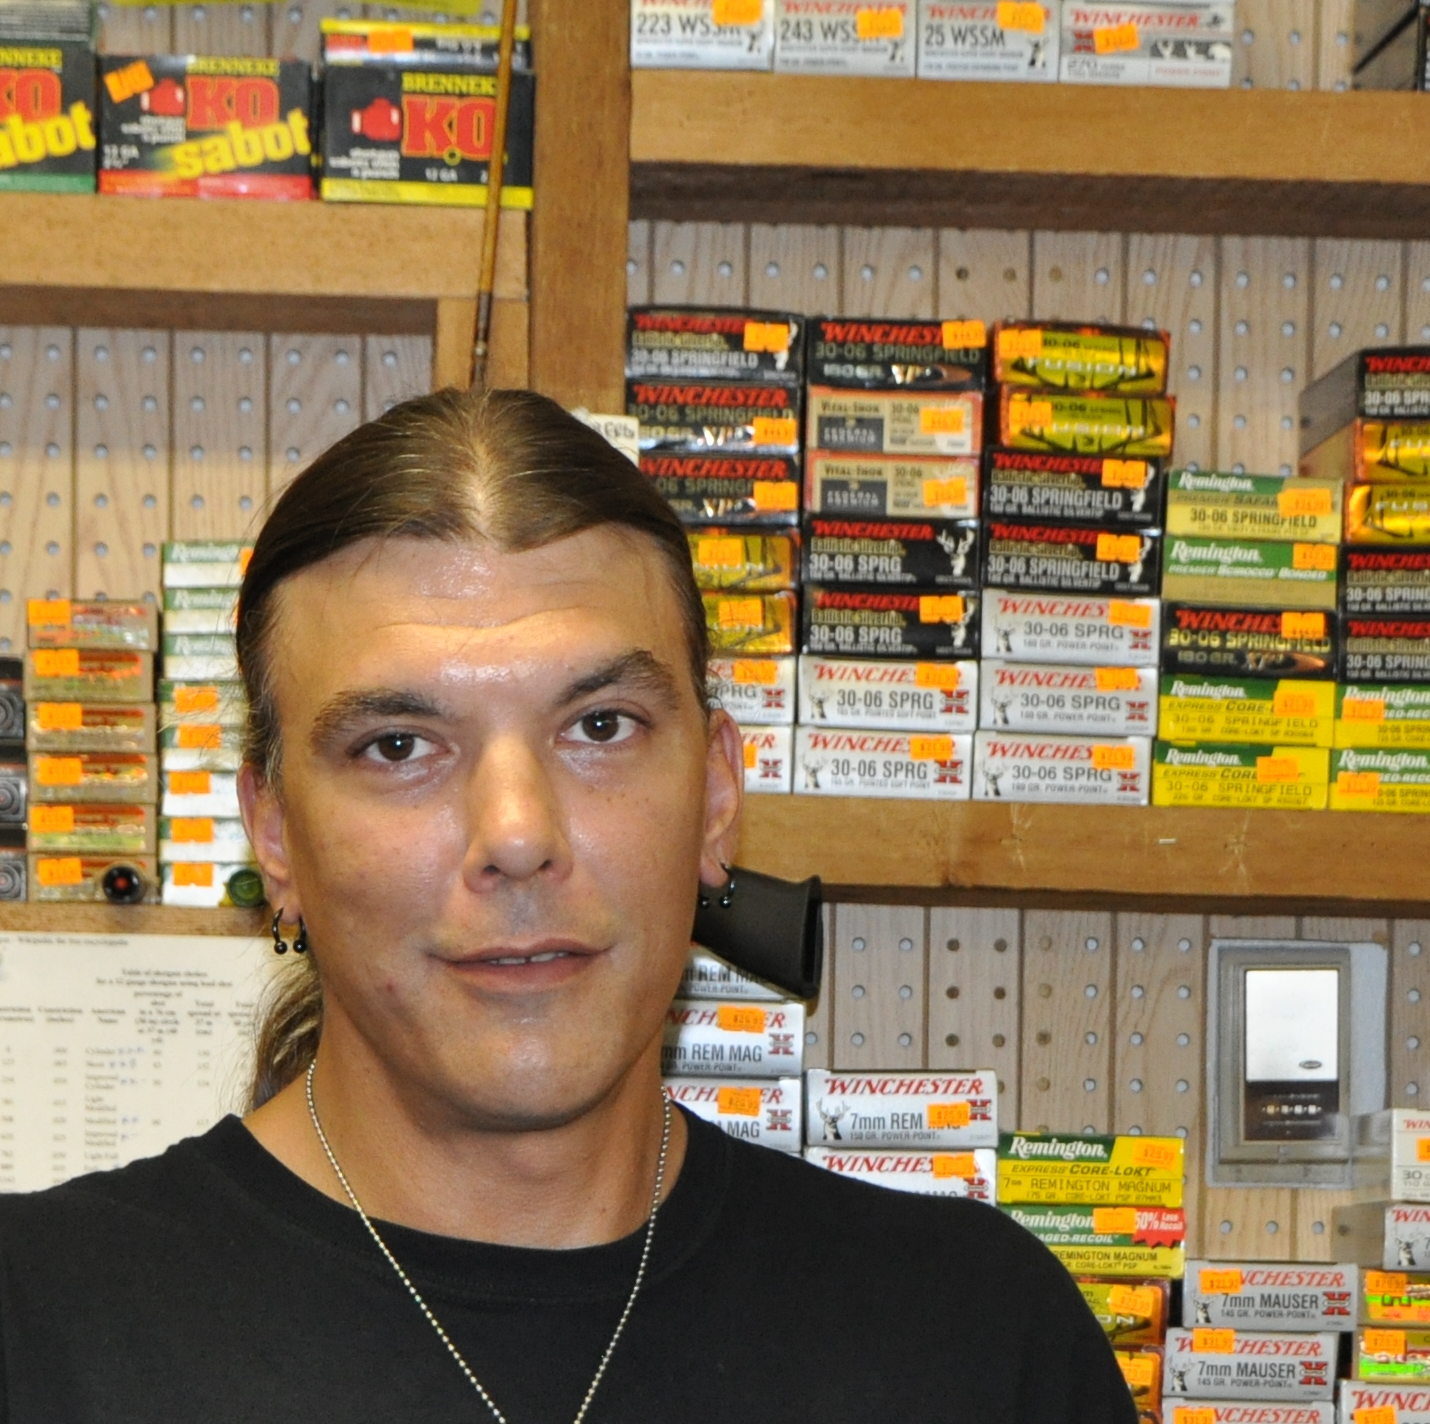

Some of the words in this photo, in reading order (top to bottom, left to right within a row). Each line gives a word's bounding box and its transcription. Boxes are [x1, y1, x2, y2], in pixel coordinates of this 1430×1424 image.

[1179, 471, 1254, 493] Remington
[1190, 509, 1226, 525] 30-06
[1229, 509, 1316, 529] SPRINGFIELD
[811, 517, 934, 542] WINCHESTER
[809, 553, 854, 573] 30-06
[858, 553, 902, 575] SPRG
[837, 689, 882, 709] 30-06
[883, 689, 934, 711] SPRG
[825, 1077, 985, 1097] WINCHESTER
[849, 1112, 887, 1131] 7mm
[890, 1113, 925, 1131] REM
[1009, 1134, 1109, 1161] Remington
[1011, 1163, 1065, 1176] EXPRESS
[1067, 1163, 1155, 1178] CORE-LOKT
[1030, 1179, 1111, 1193] REMINGTON
[1117, 1180, 1173, 1194] MAGNUM
[1221, 1293, 1257, 1309] 7mm
[1259, 1294, 1319, 1311] MAUSER
